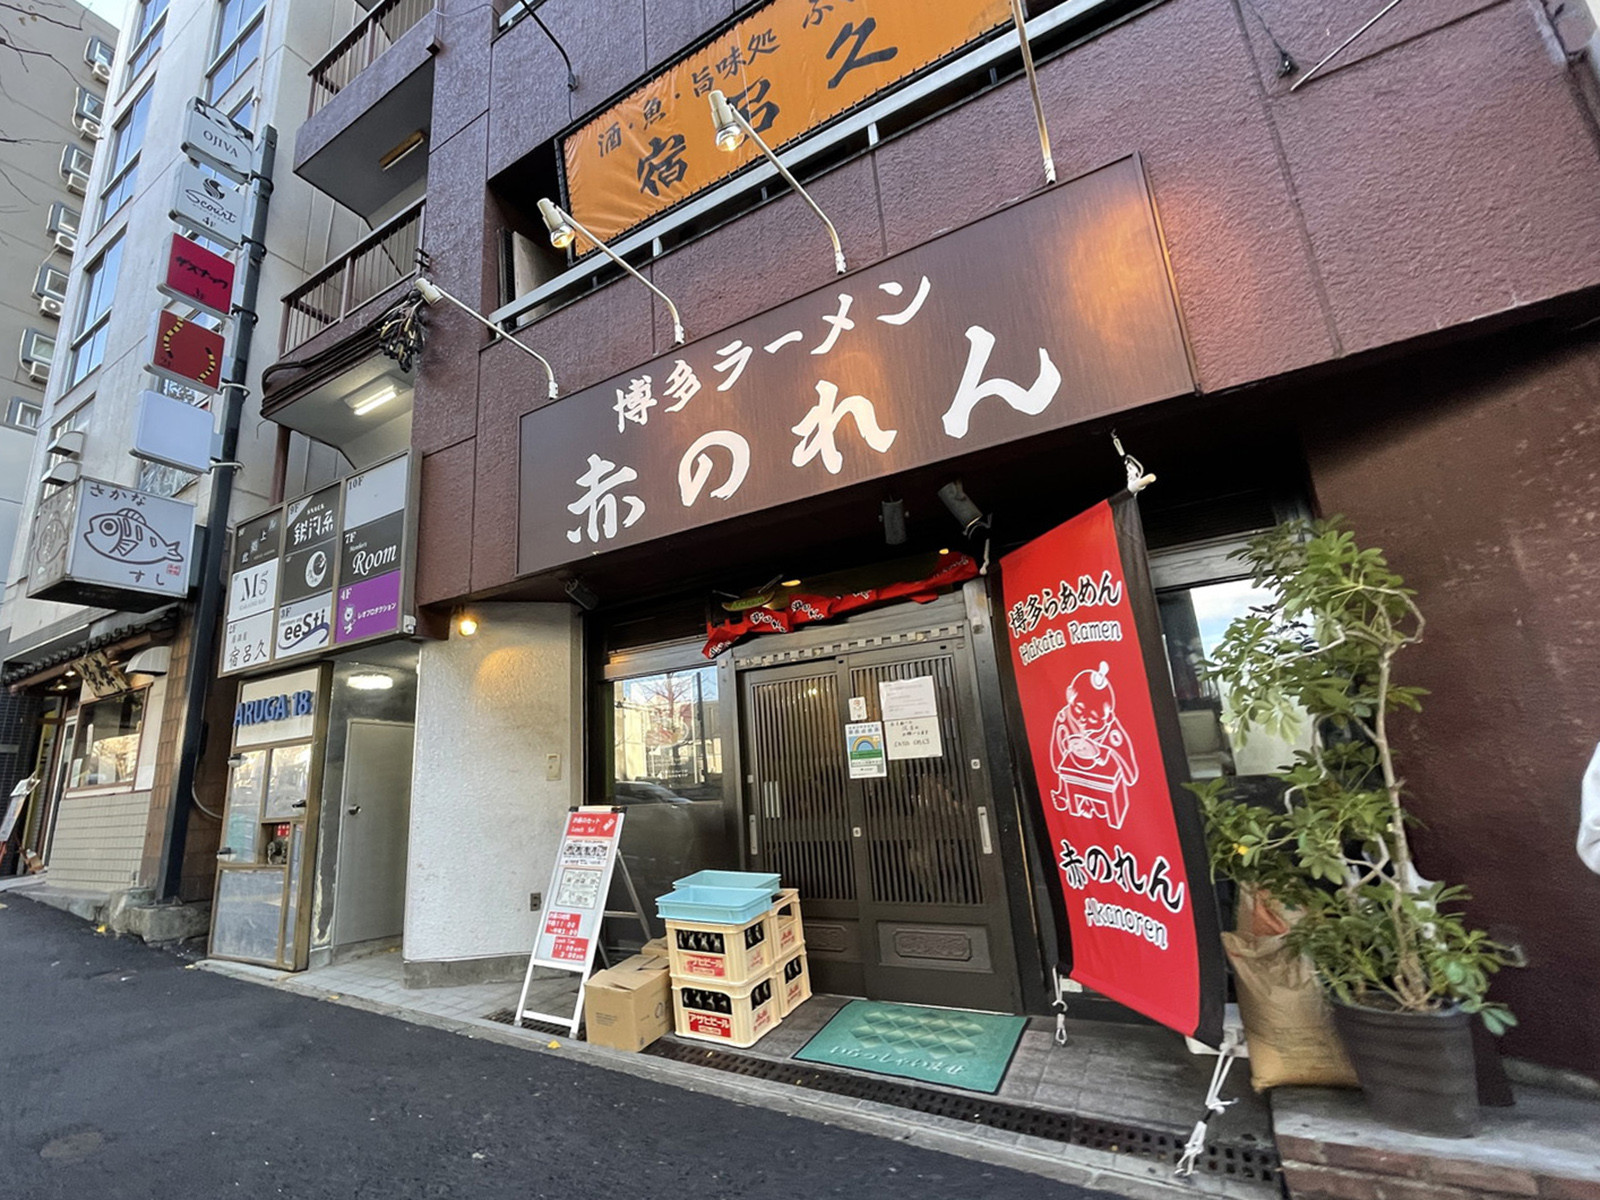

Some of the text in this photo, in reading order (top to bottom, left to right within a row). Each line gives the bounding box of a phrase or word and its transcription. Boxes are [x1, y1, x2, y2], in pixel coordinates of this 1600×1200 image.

[612, 275, 931, 433] 博多ラーメン
[567, 325, 1061, 543] 赤のれん
[90, 484, 146, 506] さかな
[348, 476, 364, 490] 10F
[344, 531, 357, 544] 7F
[352, 545, 397, 576] Room
[129, 570, 165, 586] すし
[240, 570, 269, 602] M5
[340, 588, 352, 601] 4F
[1009, 571, 1121, 638] 博多らあめん
[281, 607, 292, 618] 3F
[284, 609, 325, 641] eeSti
[1020, 621, 1122, 665] Hakata Ramen
[233, 694, 288, 727] ARUGA
[1060, 839, 1184, 912] 赤のれん
[1085, 898, 1168, 949] Akanoren
[689, 1013, 730, 1029] アサヒビール
